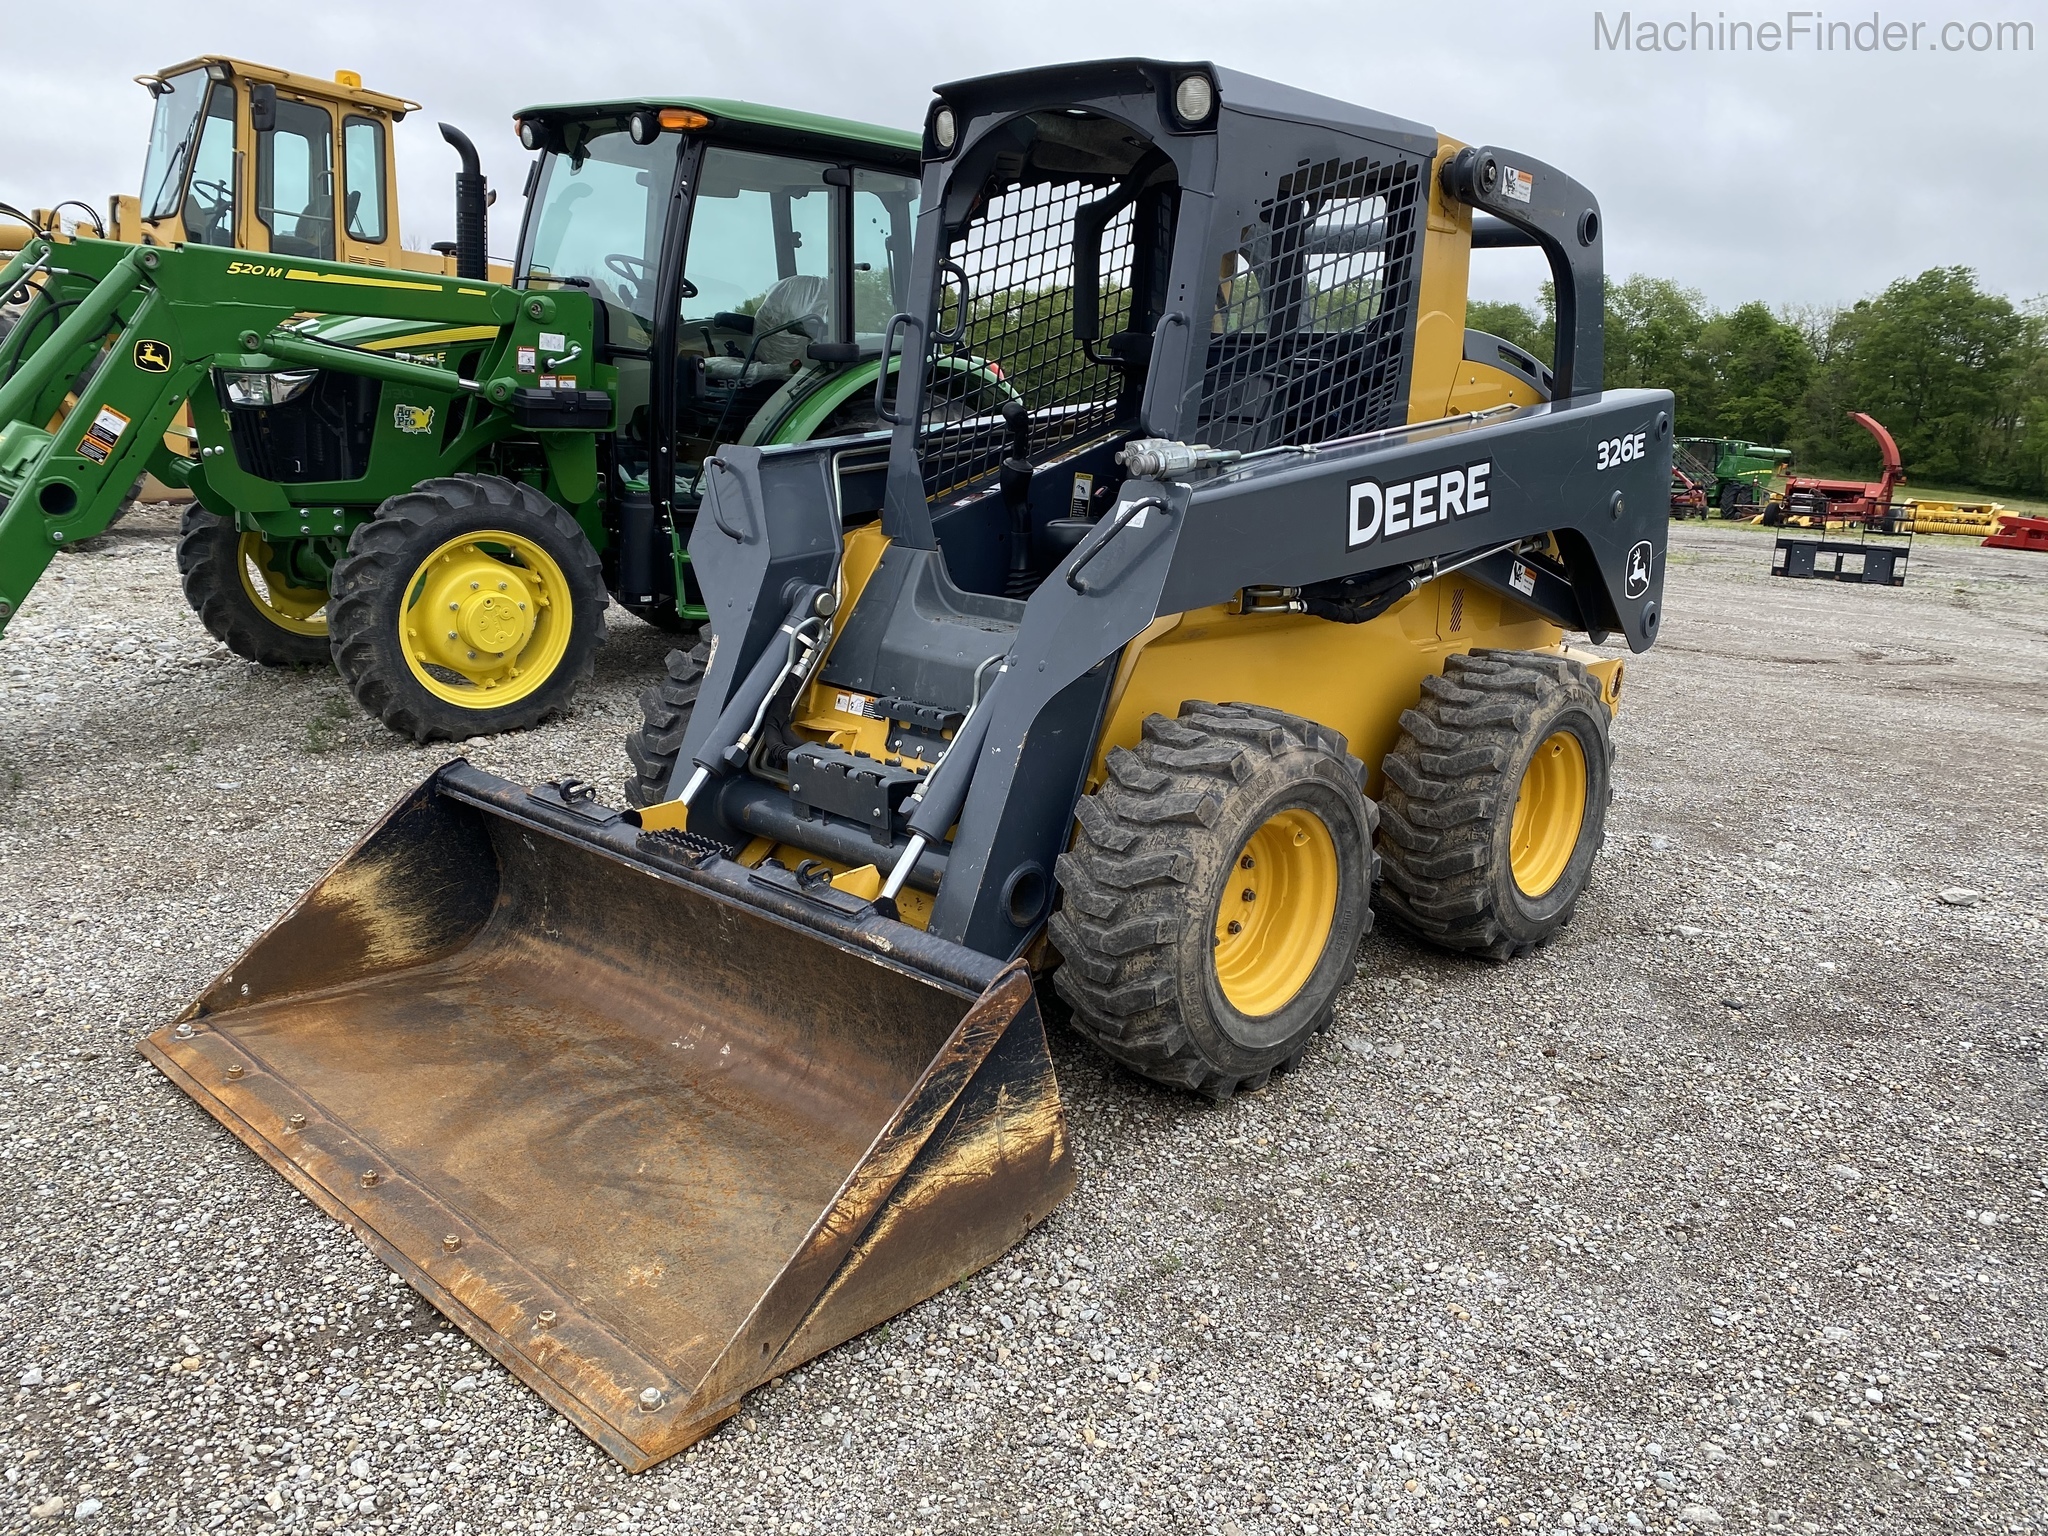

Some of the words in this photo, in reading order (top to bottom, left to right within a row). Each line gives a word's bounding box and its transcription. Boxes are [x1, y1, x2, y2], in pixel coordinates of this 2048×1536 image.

[227, 261, 265, 275] 520
[266, 267, 283, 278] M
[397, 416, 416, 426] Pro
[1596, 432, 1646, 470] 326E
[1349, 462, 1490, 547] DEERE
